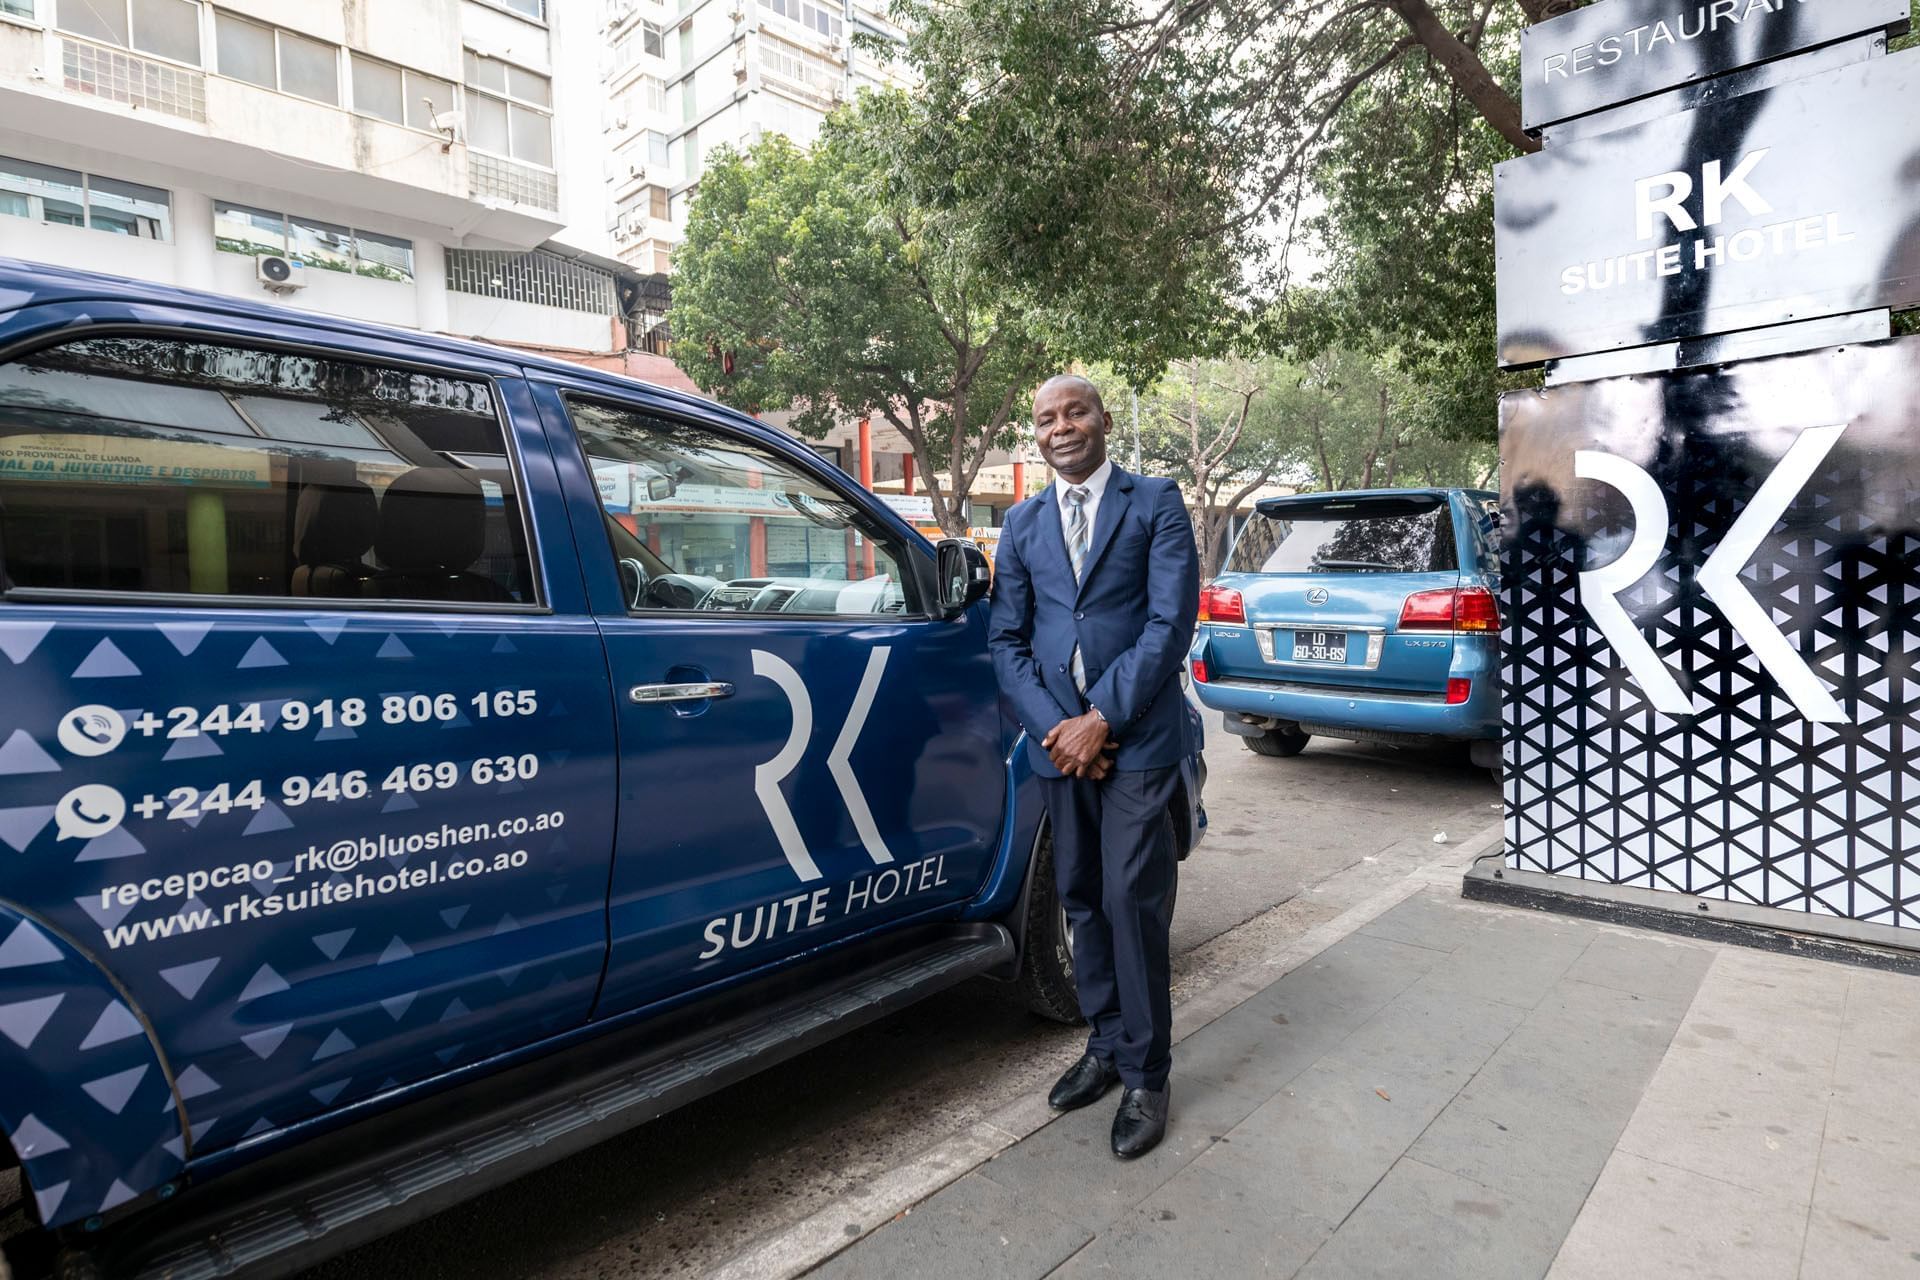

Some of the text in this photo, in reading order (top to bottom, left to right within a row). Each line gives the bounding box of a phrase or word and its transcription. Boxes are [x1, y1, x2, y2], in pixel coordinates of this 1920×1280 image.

[1544, 0, 1806, 84] RESTAURA
[1634, 147, 1773, 241] RK
[1560, 211, 1856, 296] SUITE HOTEL
[16, 450, 82, 461] PROVINCIAL
[101, 455, 141, 463] LUANDA
[32, 460, 55, 472] DA
[60, 462, 153, 476] JUVENTUDE
[158, 466, 167, 476] E
[173, 466, 257, 481] DESPORTOS
[1575, 424, 1853, 725] RK
[1313, 632, 1326, 646] LD
[1404, 640, 1448, 648] LX 570
[133, 689, 537, 739] +244 918 806 165
[133, 753, 538, 820] +244 946 469 630
[751, 646, 894, 882] RK
[101, 810, 565, 909] recepcao_rk@bluoshen.co.ao
[103, 848, 528, 949] www.rksuitehotel.co.ao
[699, 855, 947, 959] SUITE HOTEL
